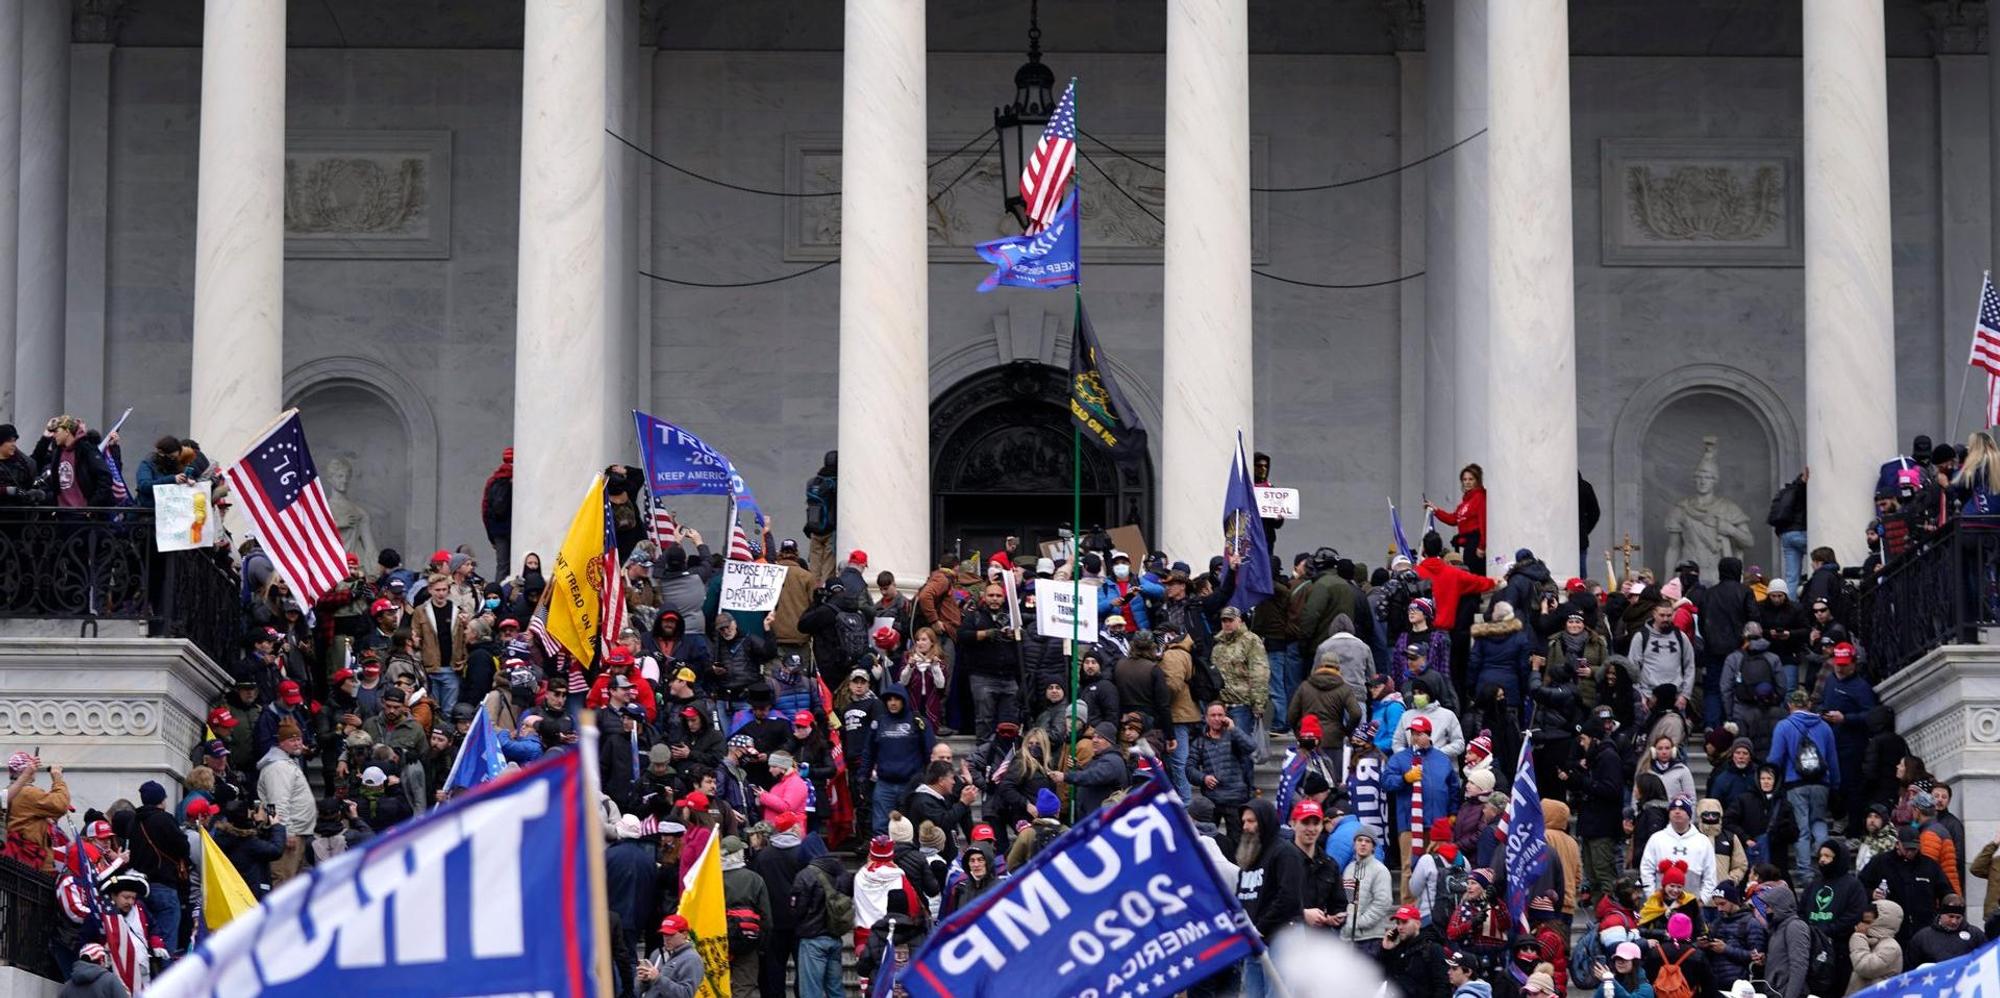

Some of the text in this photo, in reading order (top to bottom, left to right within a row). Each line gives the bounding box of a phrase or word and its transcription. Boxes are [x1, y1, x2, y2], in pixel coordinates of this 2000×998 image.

[1087, 418, 1104, 434] ON
[657, 471, 685, 481] KEEP
[1264, 491, 1289, 500] STOP
[1261, 505, 1293, 514] STEAL
[727, 562, 760, 577] EXPOSE
[565, 570, 585, 609] TREAD
[581, 612, 592, 631] ON
[587, 635, 597, 647] M
